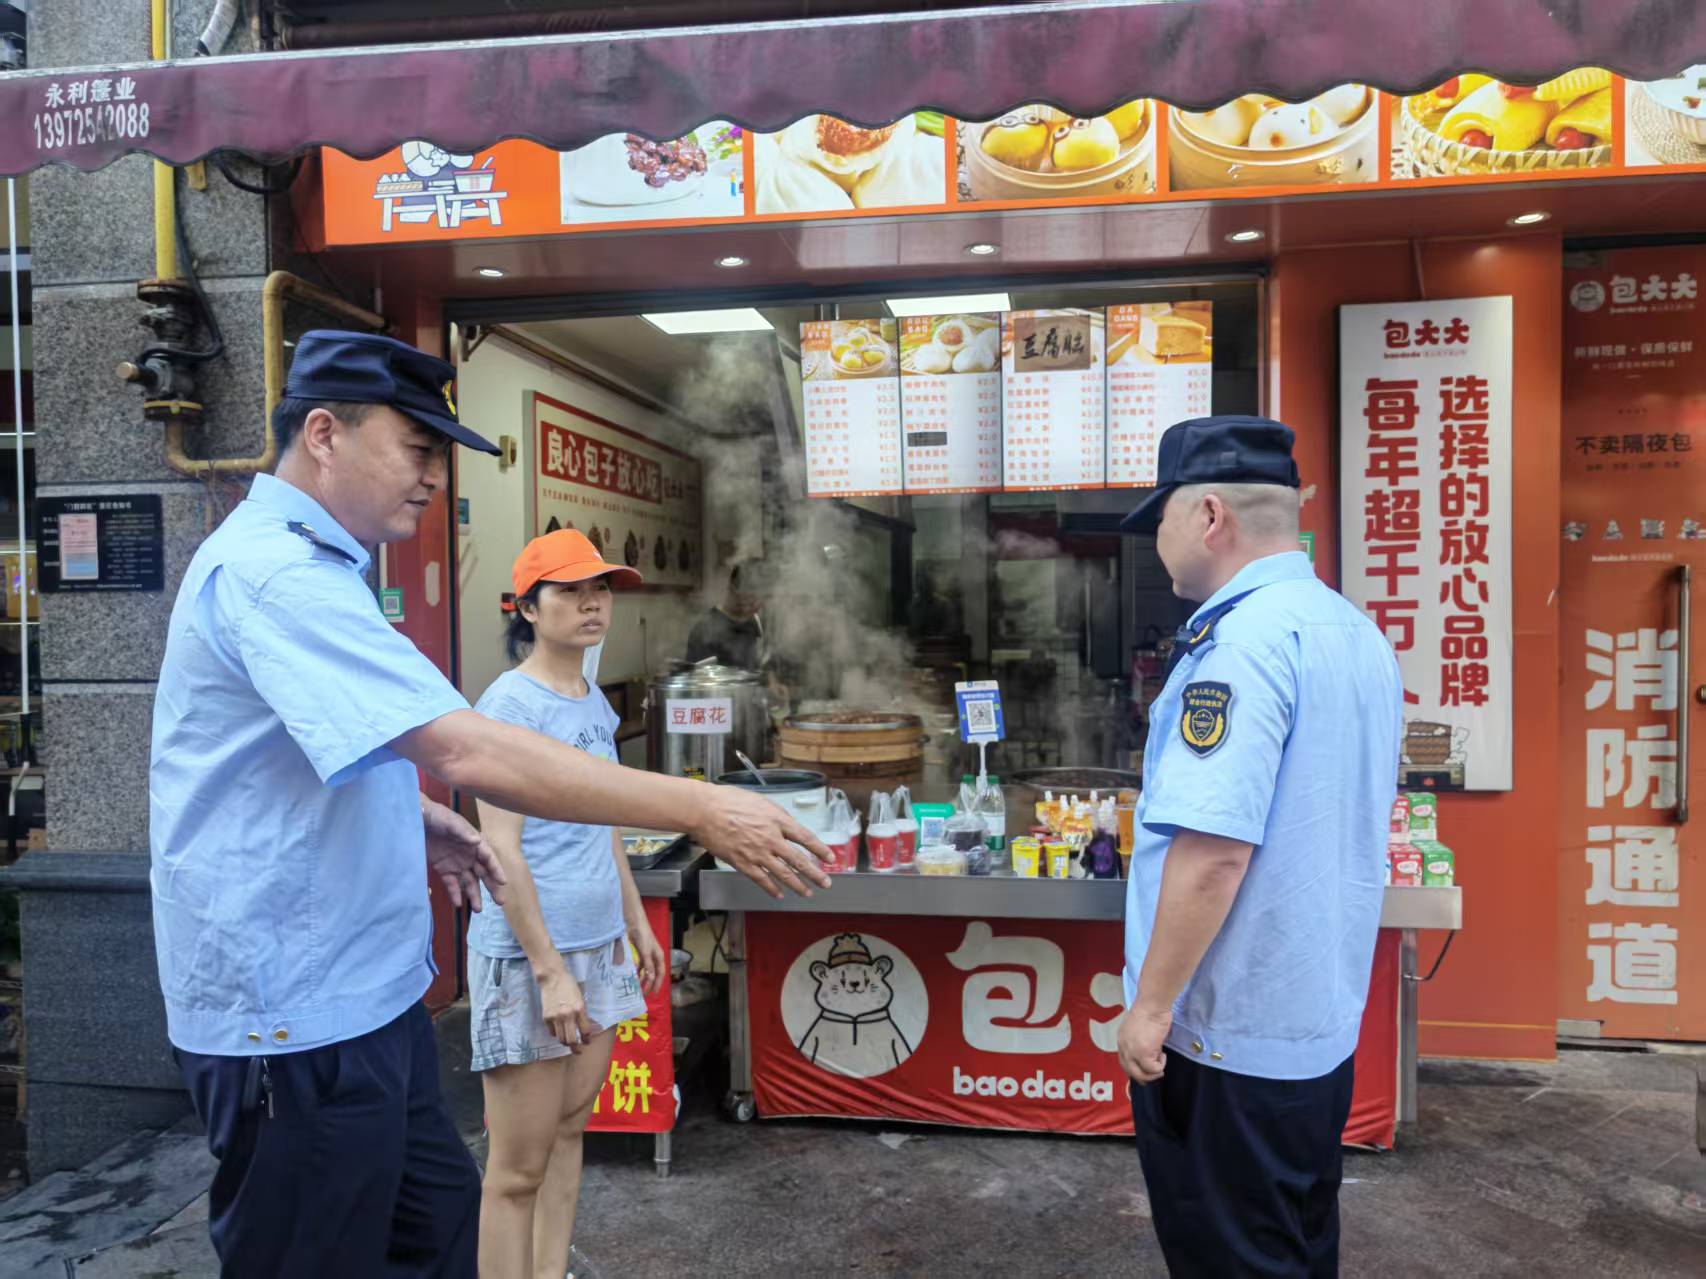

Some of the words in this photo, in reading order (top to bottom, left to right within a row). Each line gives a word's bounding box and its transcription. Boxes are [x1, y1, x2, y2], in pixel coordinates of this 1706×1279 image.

[45, 77, 136, 108] 永利篷业
[1383, 317, 1470, 349] 包大大
[1575, 433, 1693, 456] 不卖隔夜包
[1363, 377, 1421, 706] 每年超千万
[1439, 375, 1489, 707] 选择的放心品牌
[671, 706, 727, 726] 豆腐花
[1585, 628, 1679, 1004] 消防通道
